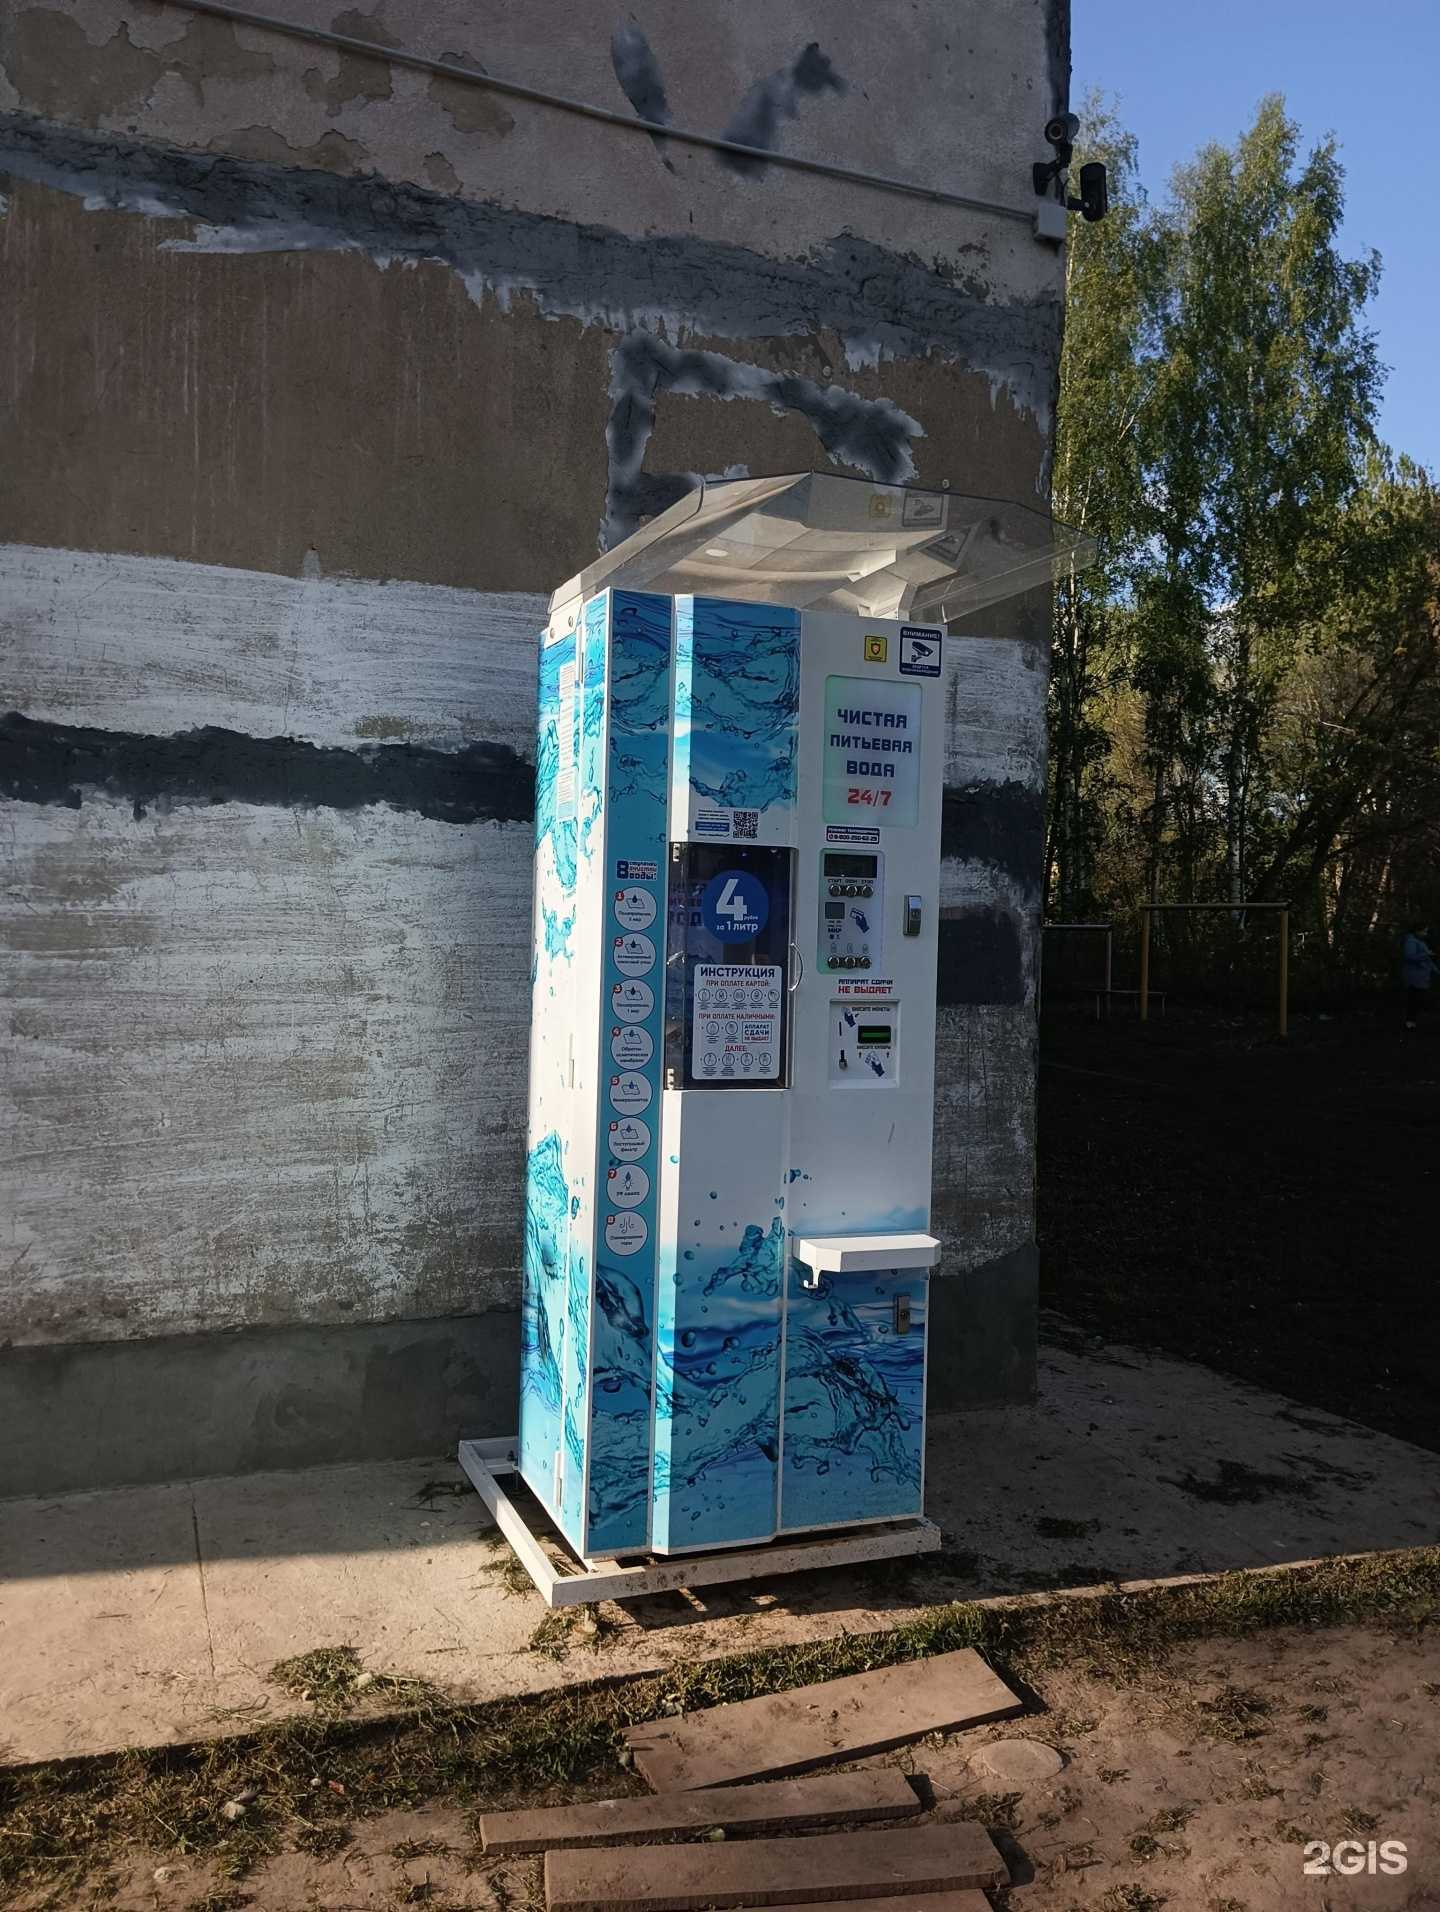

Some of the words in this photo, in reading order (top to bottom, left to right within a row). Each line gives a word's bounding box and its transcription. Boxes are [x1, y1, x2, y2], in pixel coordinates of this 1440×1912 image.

[837, 708, 907, 729] ЧИСТАЯ
[830, 734, 912, 753] ПИТЬЕВАЯ
[846, 760, 895, 778] ВОДА
[847, 788, 892, 807] 24/7
[716, 879, 748, 920] 4
[726, 921, 731, 930] 1
[733, 922, 759, 933] литр
[700, 967, 775, 978] ИНСТРУКЦИЯ
[838, 986, 851, 994] НЕ
